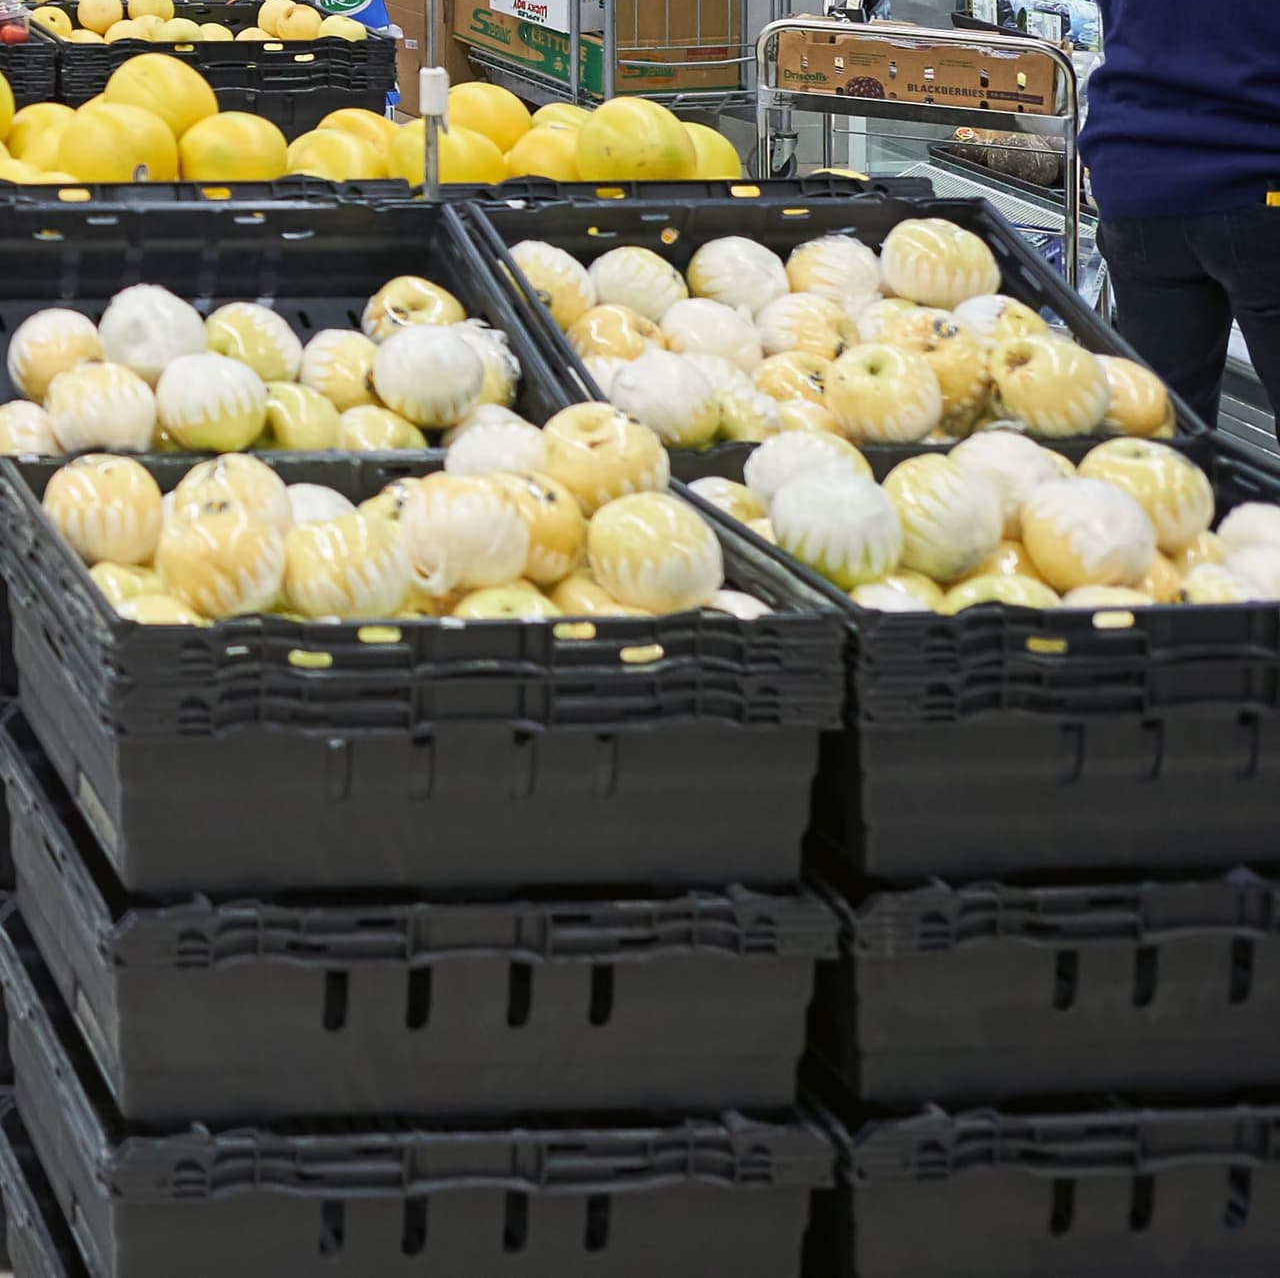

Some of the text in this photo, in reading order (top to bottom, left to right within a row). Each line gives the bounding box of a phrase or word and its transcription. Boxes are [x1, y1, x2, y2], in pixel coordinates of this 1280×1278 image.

[527, 1, 548, 19] LUCKY
[532, 28, 587, 62] LETTUE
[907, 83, 985, 99] BLACKBERRIES
